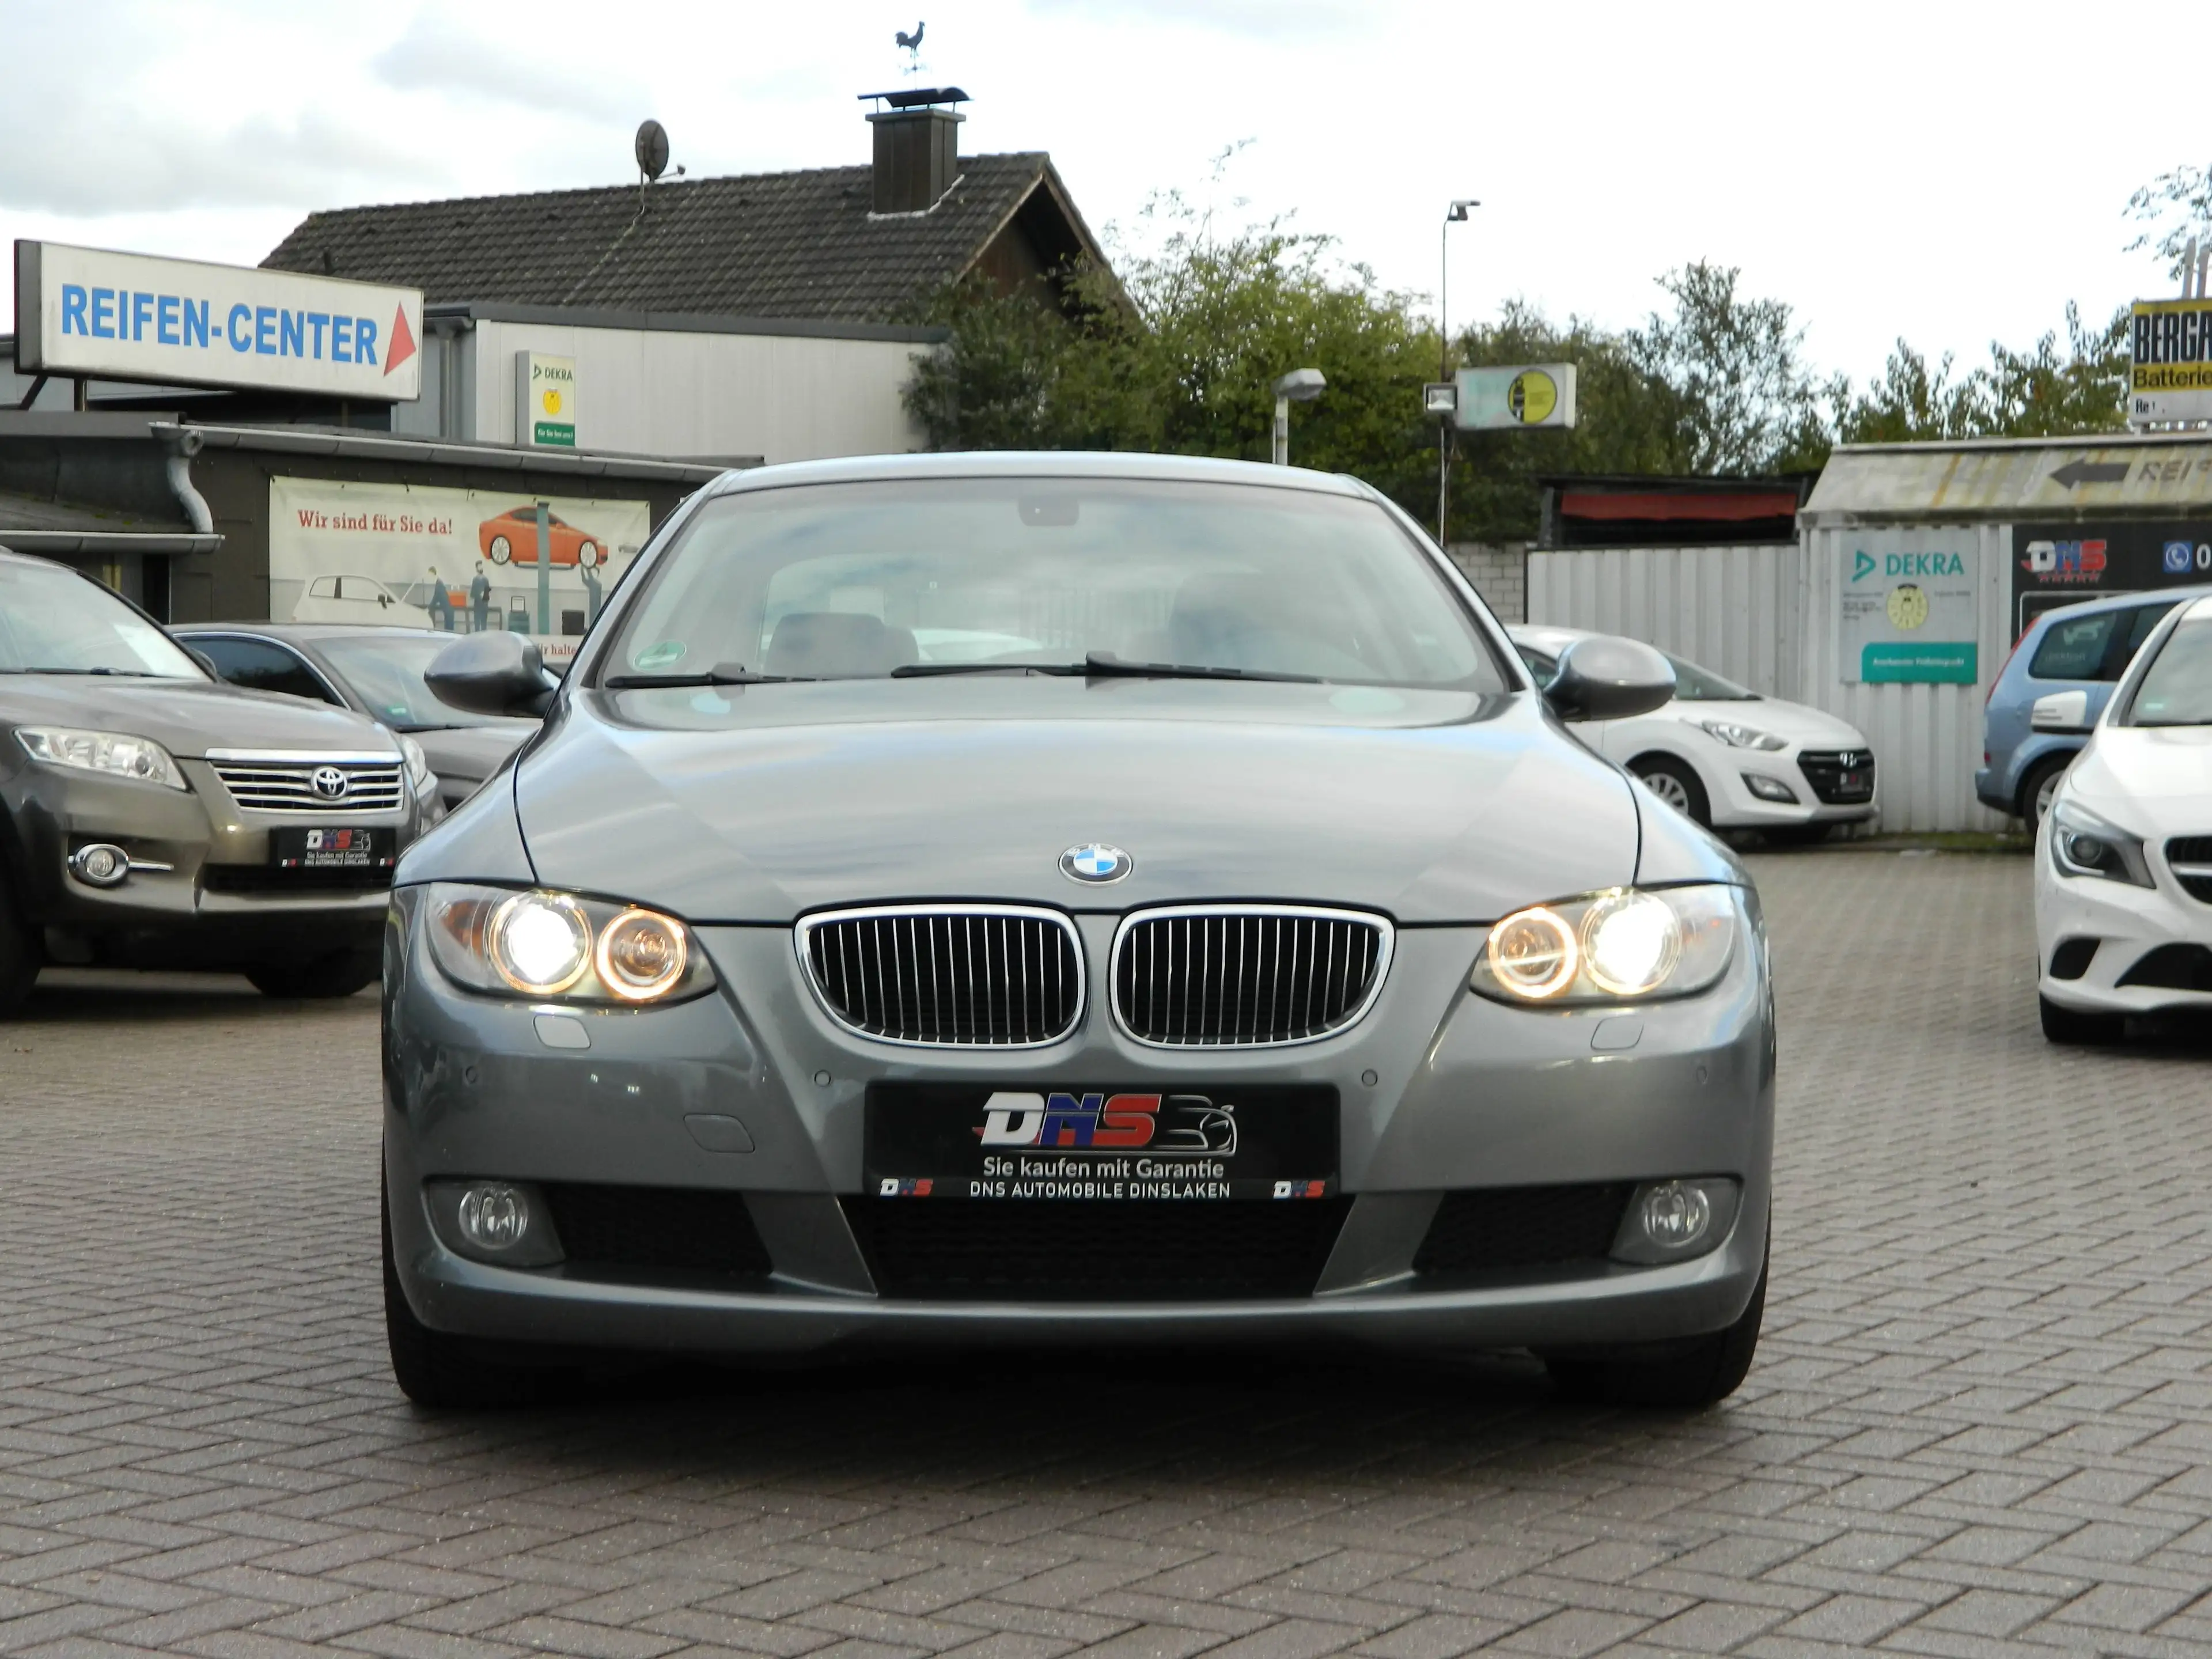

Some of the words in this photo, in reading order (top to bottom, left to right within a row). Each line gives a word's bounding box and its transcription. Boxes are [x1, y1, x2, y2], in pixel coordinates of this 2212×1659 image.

[62, 283, 378, 366] REIFEN-CENTER
[544, 366, 573, 381] DEKRA
[297, 509, 328, 529] Wir
[332, 512, 368, 531] sind
[372, 513, 396, 532] für
[400, 515, 423, 532] Sie
[428, 517, 452, 535] da!
[1885, 551, 1965, 577] DEKRA
[2027, 539, 2107, 572] DNS
[981, 1092, 1162, 1146] DNS
[983, 1157, 1013, 1177] Sie
[1021, 1157, 1090, 1178] kaufen
[1097, 1159, 1131, 1178] mit
[1137, 1158, 1224, 1179] Garantie
[970, 1181, 1006, 1198] DNS
[1012, 1181, 1123, 1198] AUTOMOBILE
[1130, 1183, 1230, 1199] DINSLAKEN
